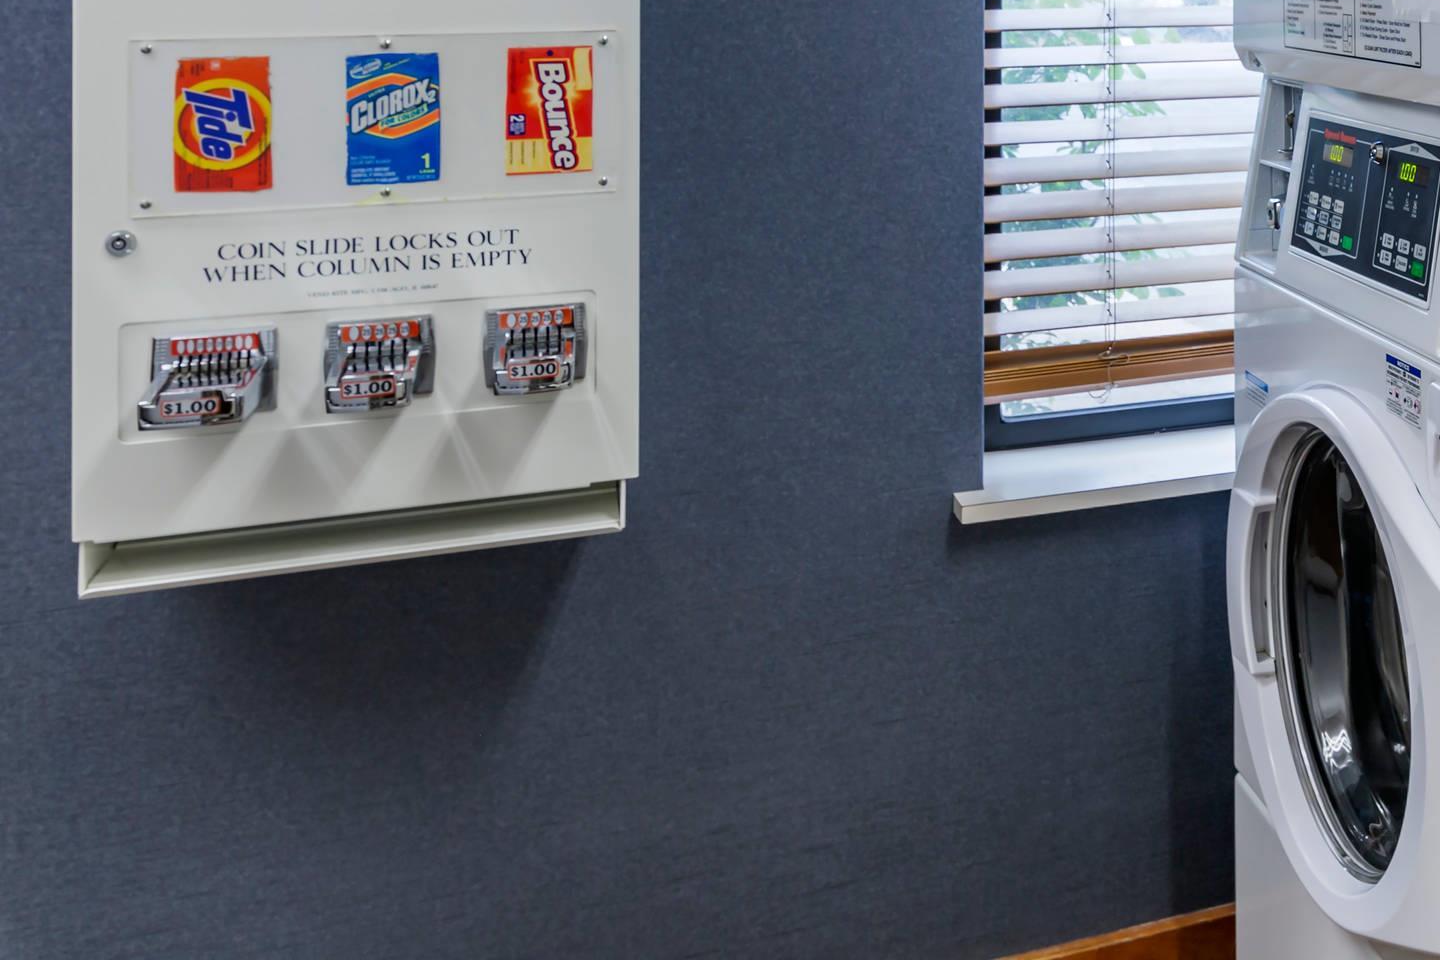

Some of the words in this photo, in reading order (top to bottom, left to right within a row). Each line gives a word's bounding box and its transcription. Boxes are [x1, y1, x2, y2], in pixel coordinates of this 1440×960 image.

[182, 88, 255, 161] Tide
[538, 63, 576, 169] Bounce
[421, 153, 430, 168] 1
[218, 241, 287, 261] COIN
[295, 236, 365, 257] SLIDE
[374, 231, 458, 252] LOCKS
[467, 228, 520, 247] OUT
[203, 262, 287, 283] WHEN
[297, 254, 411, 279] COLUMN
[421, 253, 441, 271] IS
[451, 248, 533, 268] EMPTY
[511, 363, 556, 377] $1.00
[344, 381, 392, 395] $1.00
[164, 400, 216, 415] $1.00
